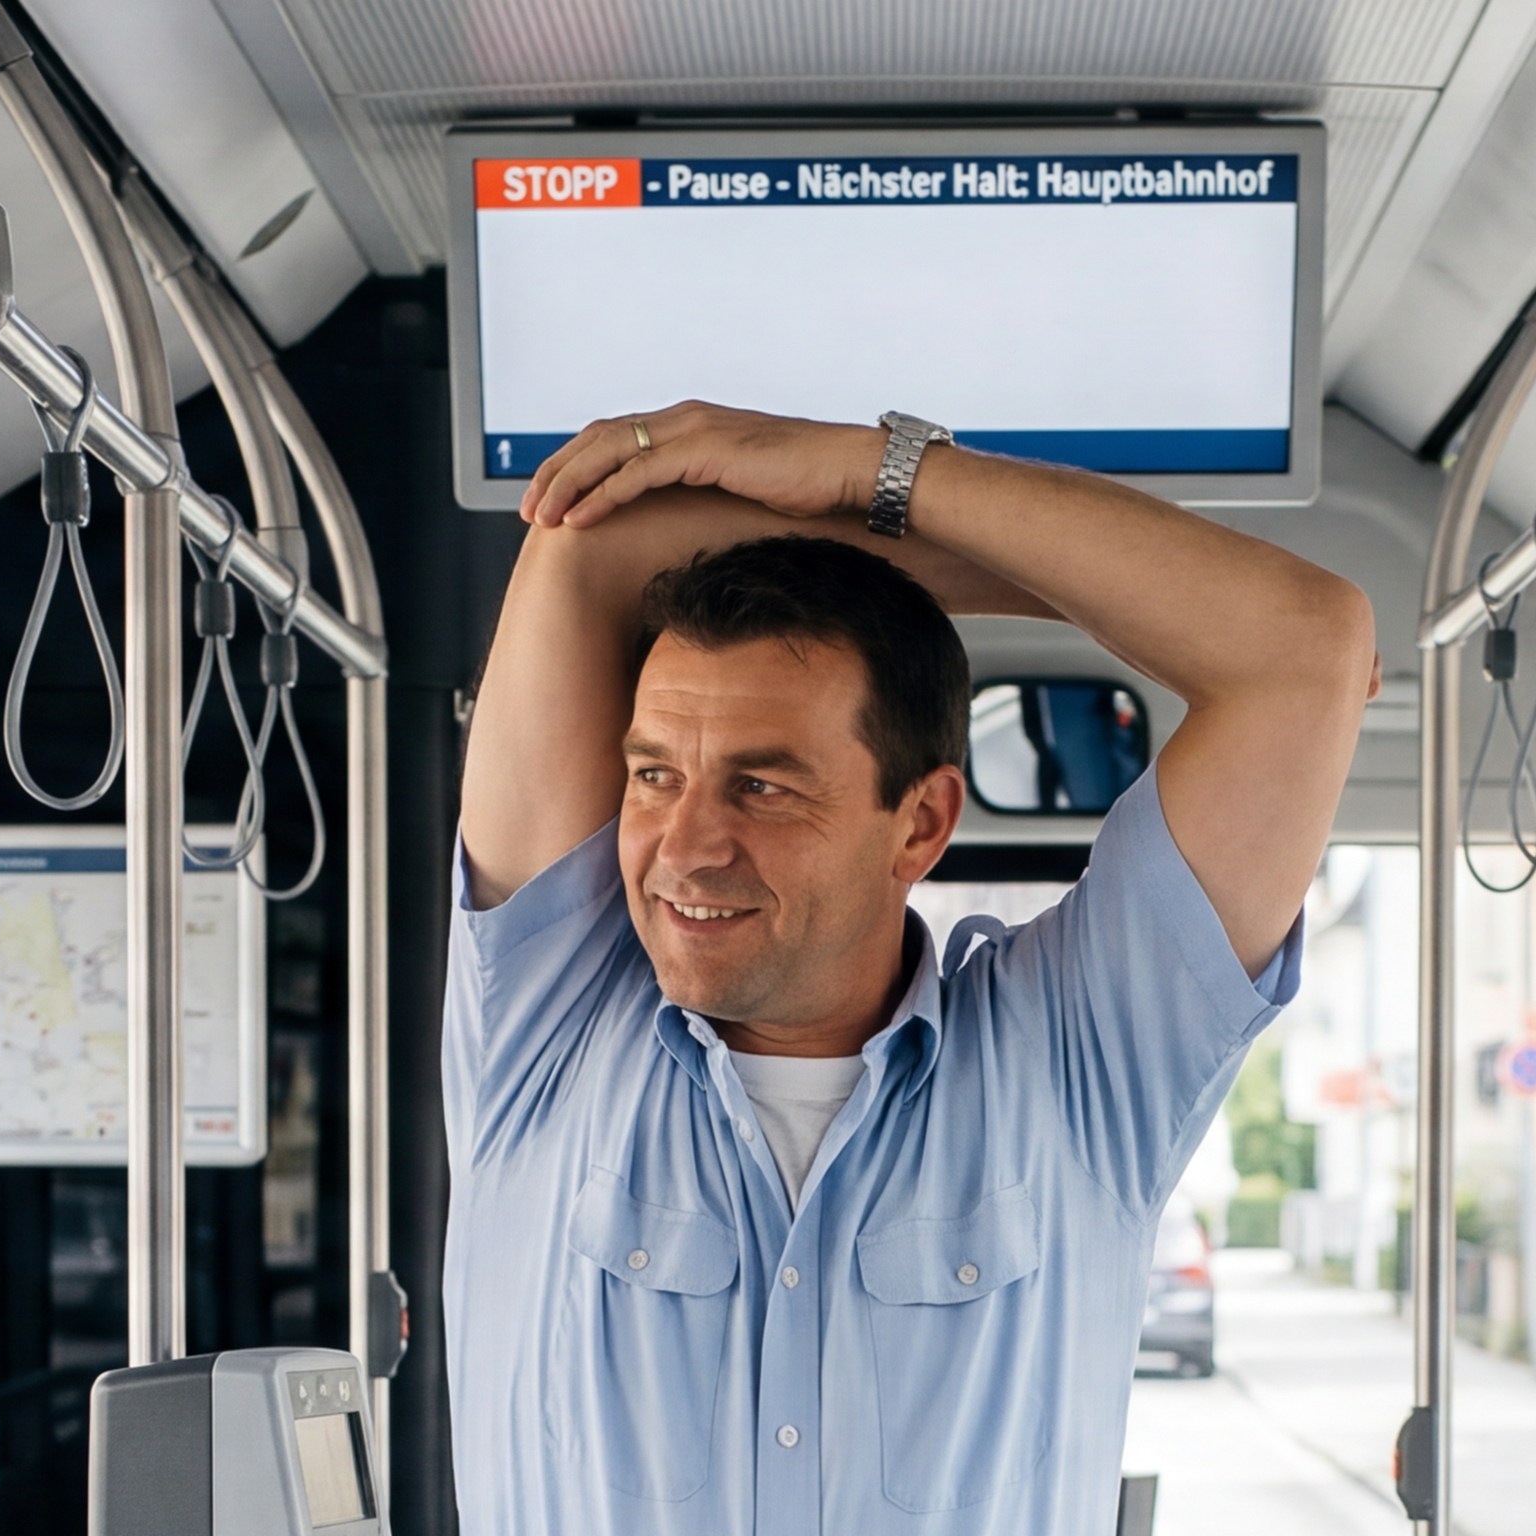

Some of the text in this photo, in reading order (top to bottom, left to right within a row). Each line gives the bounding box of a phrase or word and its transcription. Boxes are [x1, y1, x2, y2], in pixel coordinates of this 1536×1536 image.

[504, 166, 617, 201] STOPP
[669, 165, 769, 199] Pause
[799, 164, 945, 197] Nächster
[954, 163, 1028, 197] Halt:
[1038, 161, 1273, 204] Hauptbahnhof
